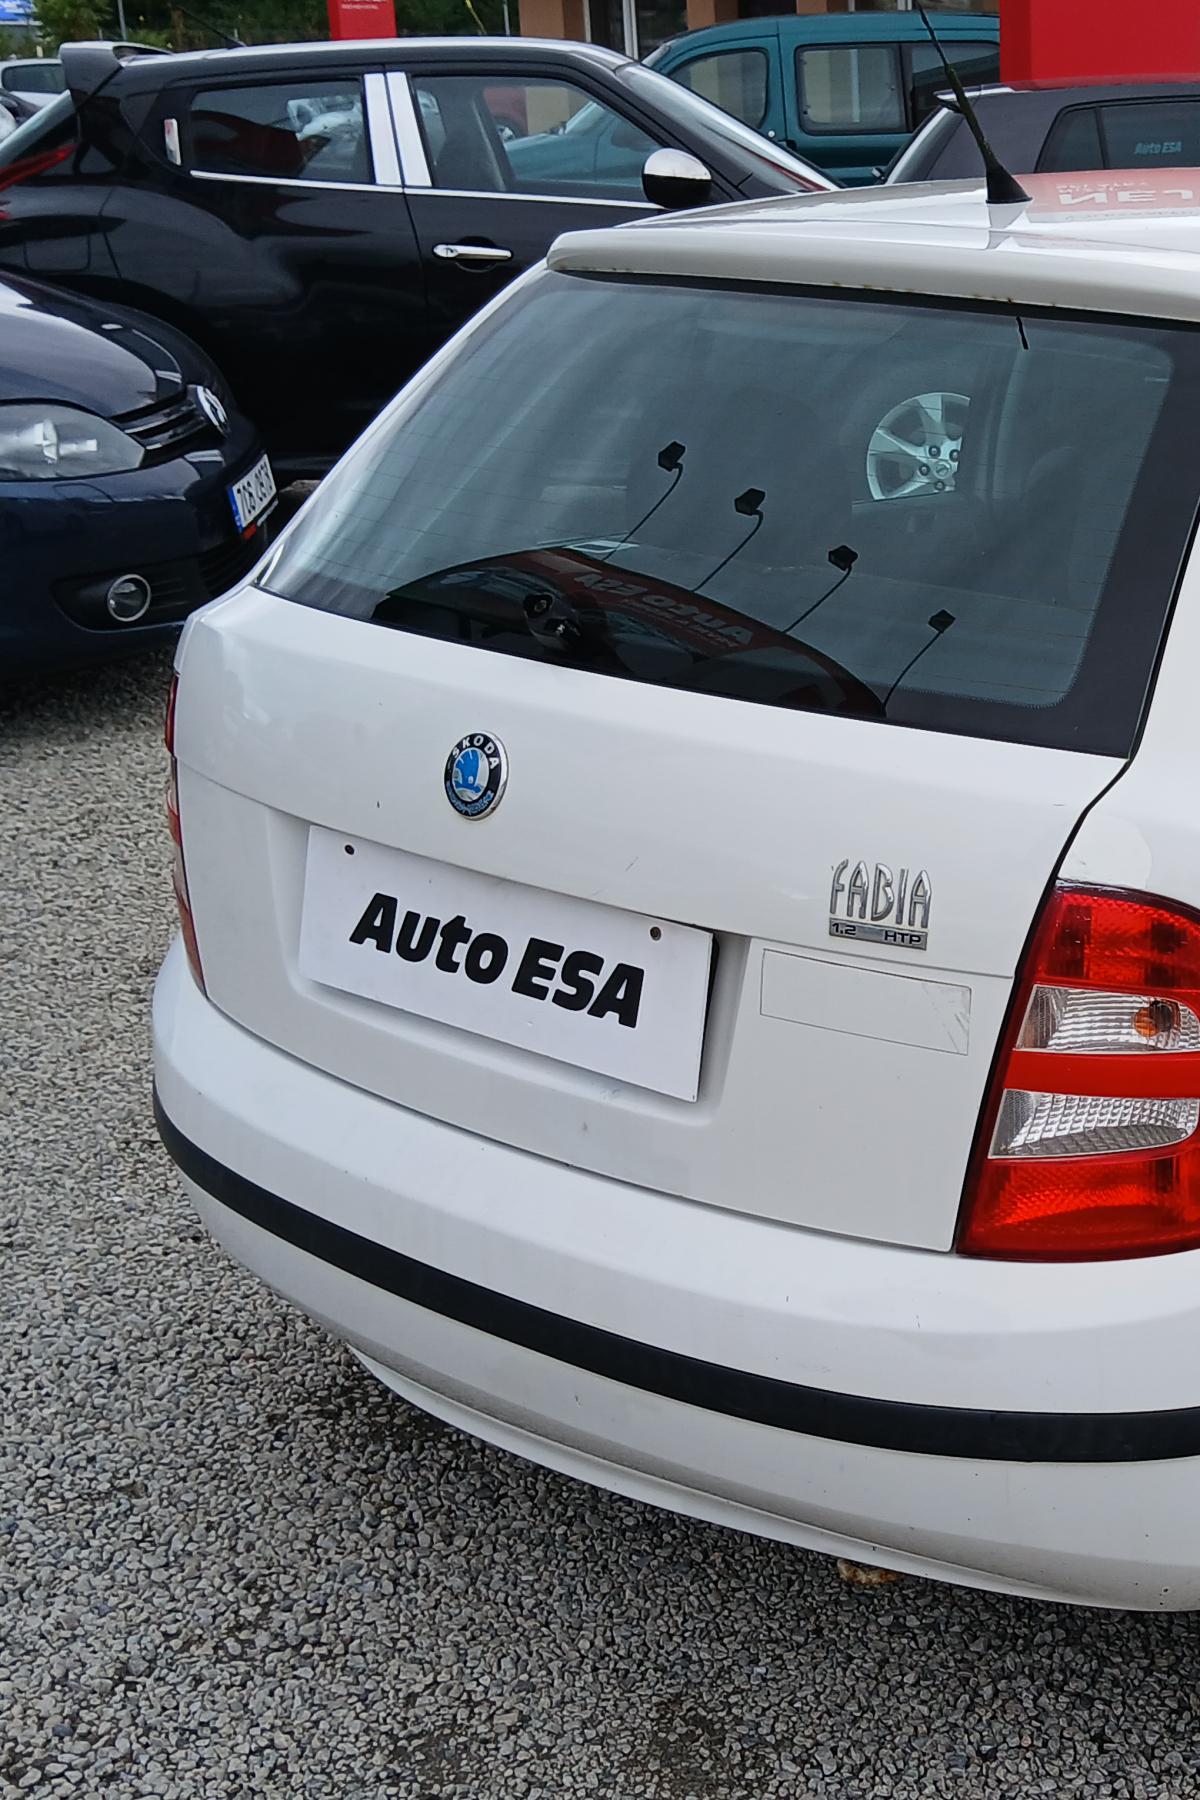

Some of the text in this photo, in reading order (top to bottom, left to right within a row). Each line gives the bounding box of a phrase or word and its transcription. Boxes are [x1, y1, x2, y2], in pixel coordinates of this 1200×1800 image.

[1161, 141, 1182, 153] ESA
[830, 859, 932, 928] FABIA
[832, 922, 922, 945] 1.2 HTP
[349, 892, 645, 1029] Auto ESA
